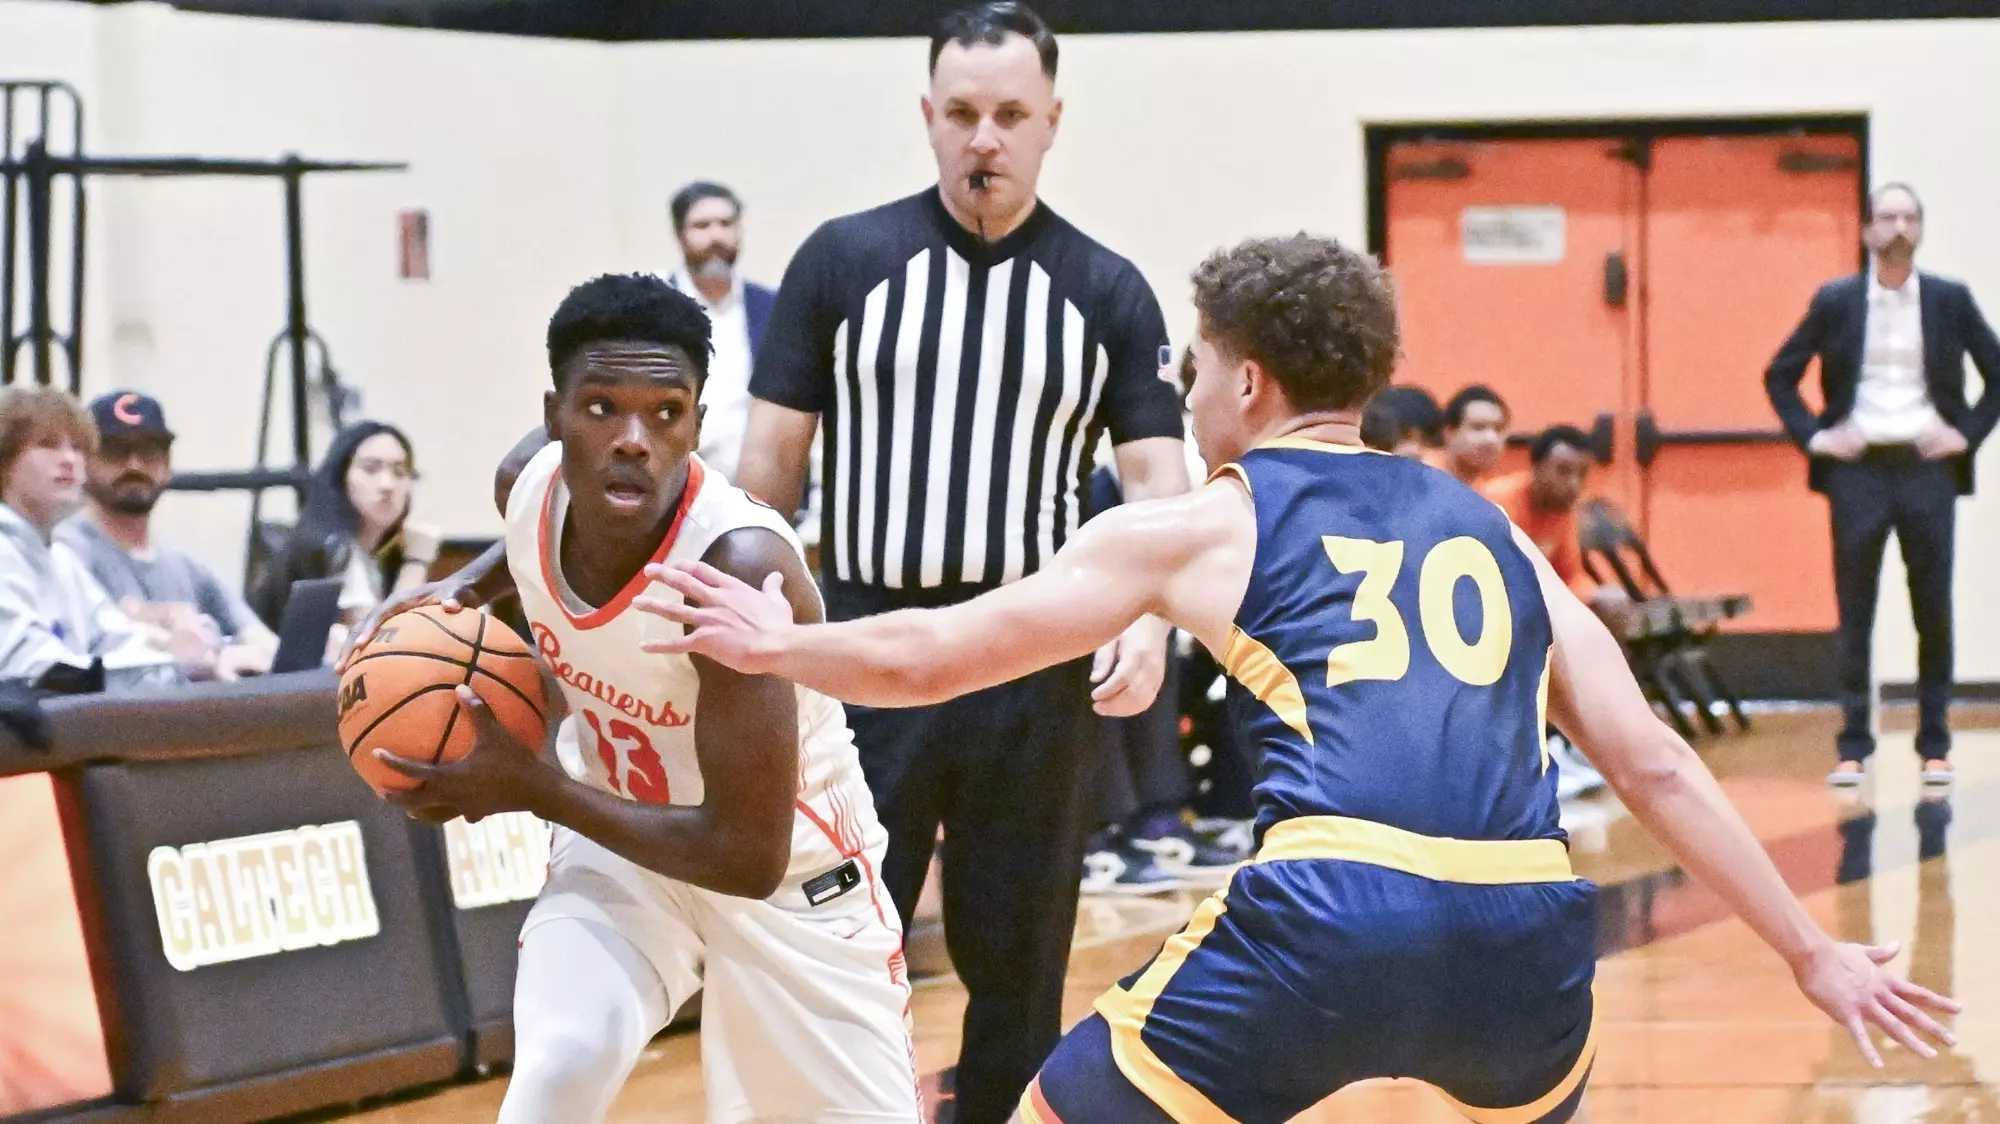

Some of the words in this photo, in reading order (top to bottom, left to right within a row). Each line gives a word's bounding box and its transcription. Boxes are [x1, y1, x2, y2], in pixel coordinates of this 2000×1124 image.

[114, 393, 145, 426] C
[1320, 535, 1513, 688] 30
[531, 621, 691, 727] Beavers
[582, 707, 672, 805] 13
[157, 834, 370, 956] CALTECH
